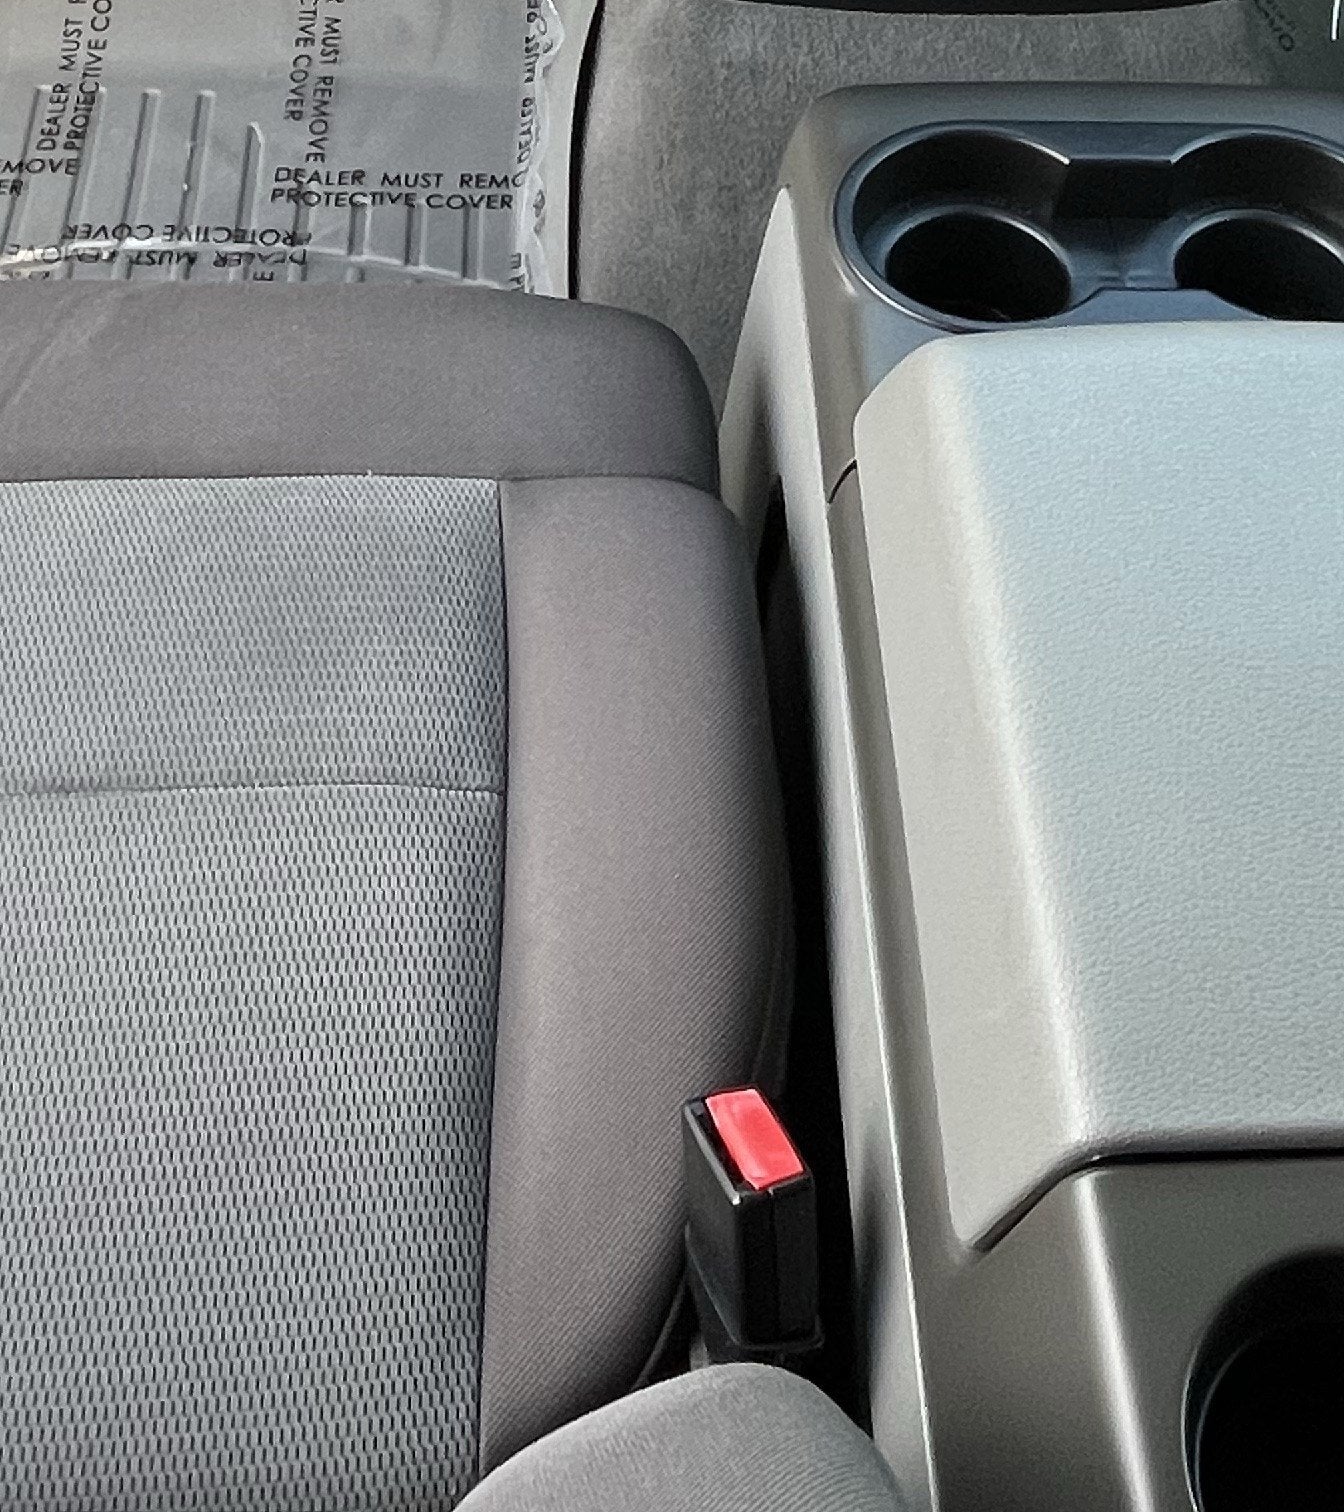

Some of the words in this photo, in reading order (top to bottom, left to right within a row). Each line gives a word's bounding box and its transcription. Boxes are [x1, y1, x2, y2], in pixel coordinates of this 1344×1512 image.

[319, 16, 343, 66] MUST
[36, 82, 72, 152] DEALER
[59, 17, 84, 72] MUST
[63, 37, 109, 152] PROTECTIVE
[283, 54, 314, 122] COVER
[305, 75, 335, 165] REMOVE
[270, 188, 417, 208] PROTECTIVE
[425, 193, 514, 211] COVER
[274, 166, 366, 187] DEALER
[380, 172, 443, 189] MUST
[458, 170, 529, 190] REMO
[60, 222, 154, 240] COVER
